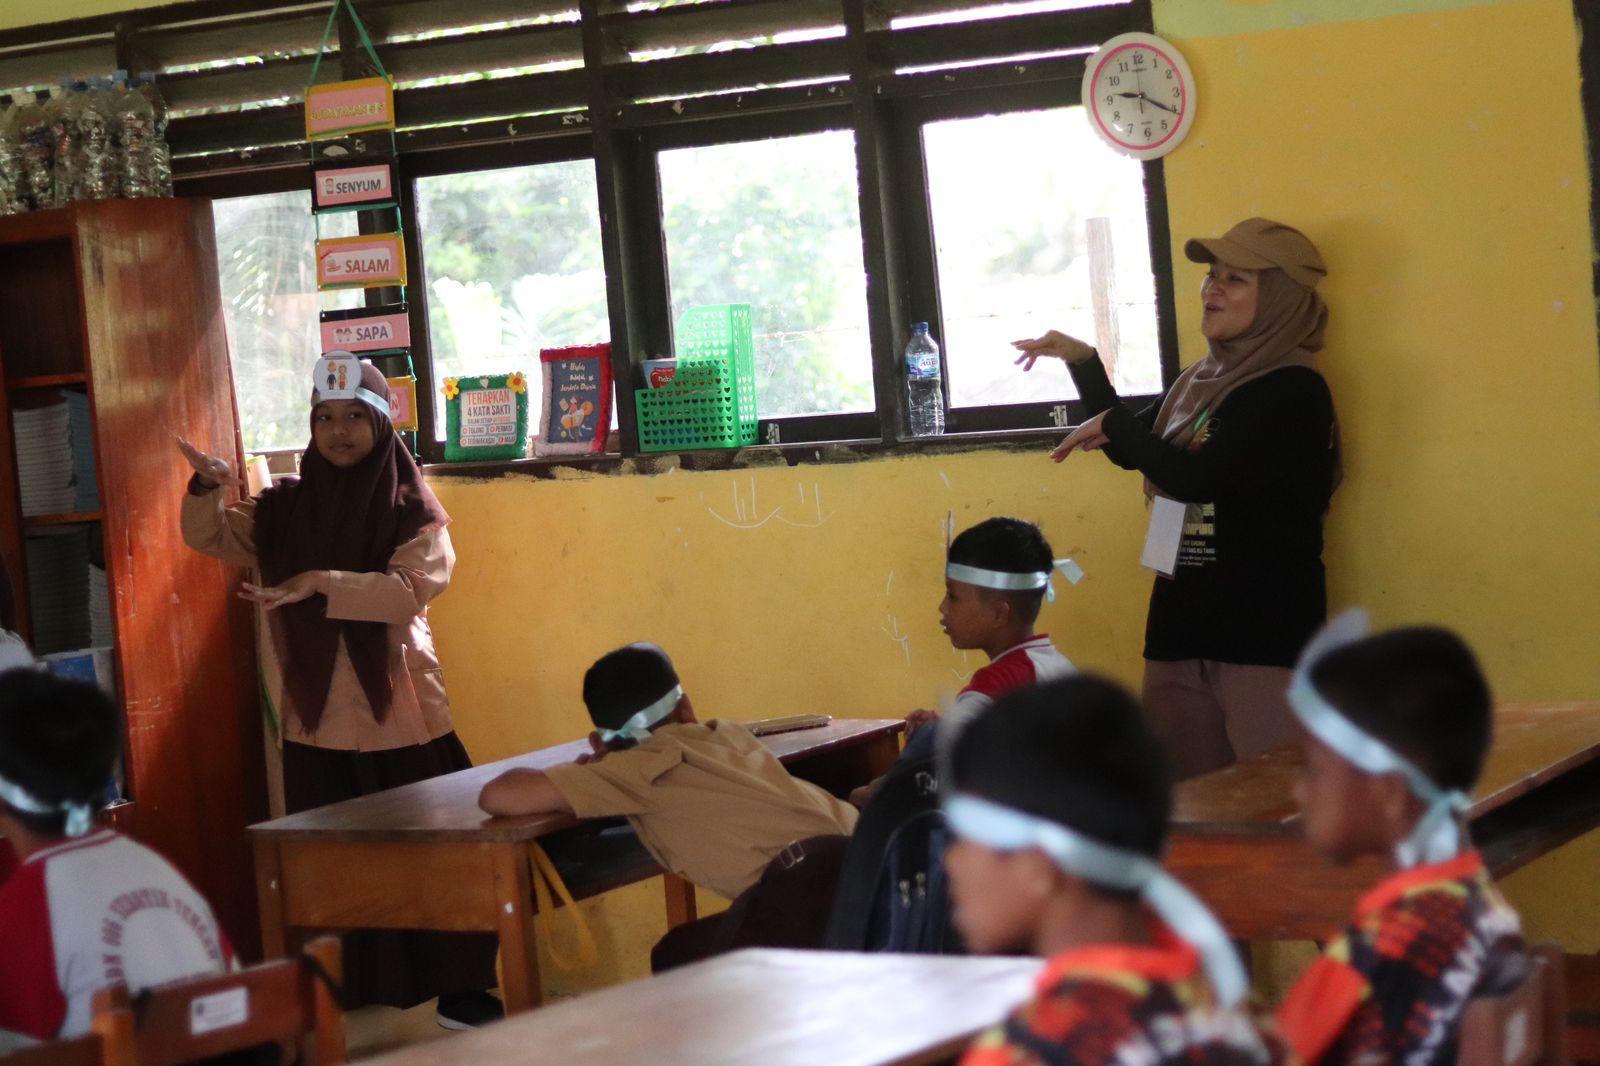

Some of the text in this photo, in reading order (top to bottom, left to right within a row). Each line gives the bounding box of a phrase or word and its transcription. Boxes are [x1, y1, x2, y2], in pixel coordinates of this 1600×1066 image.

[1133, 54, 1144, 65] 12
[1153, 58, 1158, 68] 1
[1119, 62, 1129, 72] 11
[1165, 69, 1173, 80] 2
[1109, 76, 1120, 86] 10
[1172, 87, 1180, 97] 3
[1106, 95, 1114, 105] 9
[1113, 111, 1121, 121] 8
[1128, 123, 1134, 134] 7
[1161, 120, 1168, 130] 5
[1144, 127, 1152, 138] 6
[336, 178, 381, 194] SENYUM
[345, 258, 390, 273] SALAM
[356, 325, 389, 341] SAPA
[467, 390, 510, 405] TERAPKAN
[467, 404, 511, 417] 4 KATA SAKTI
